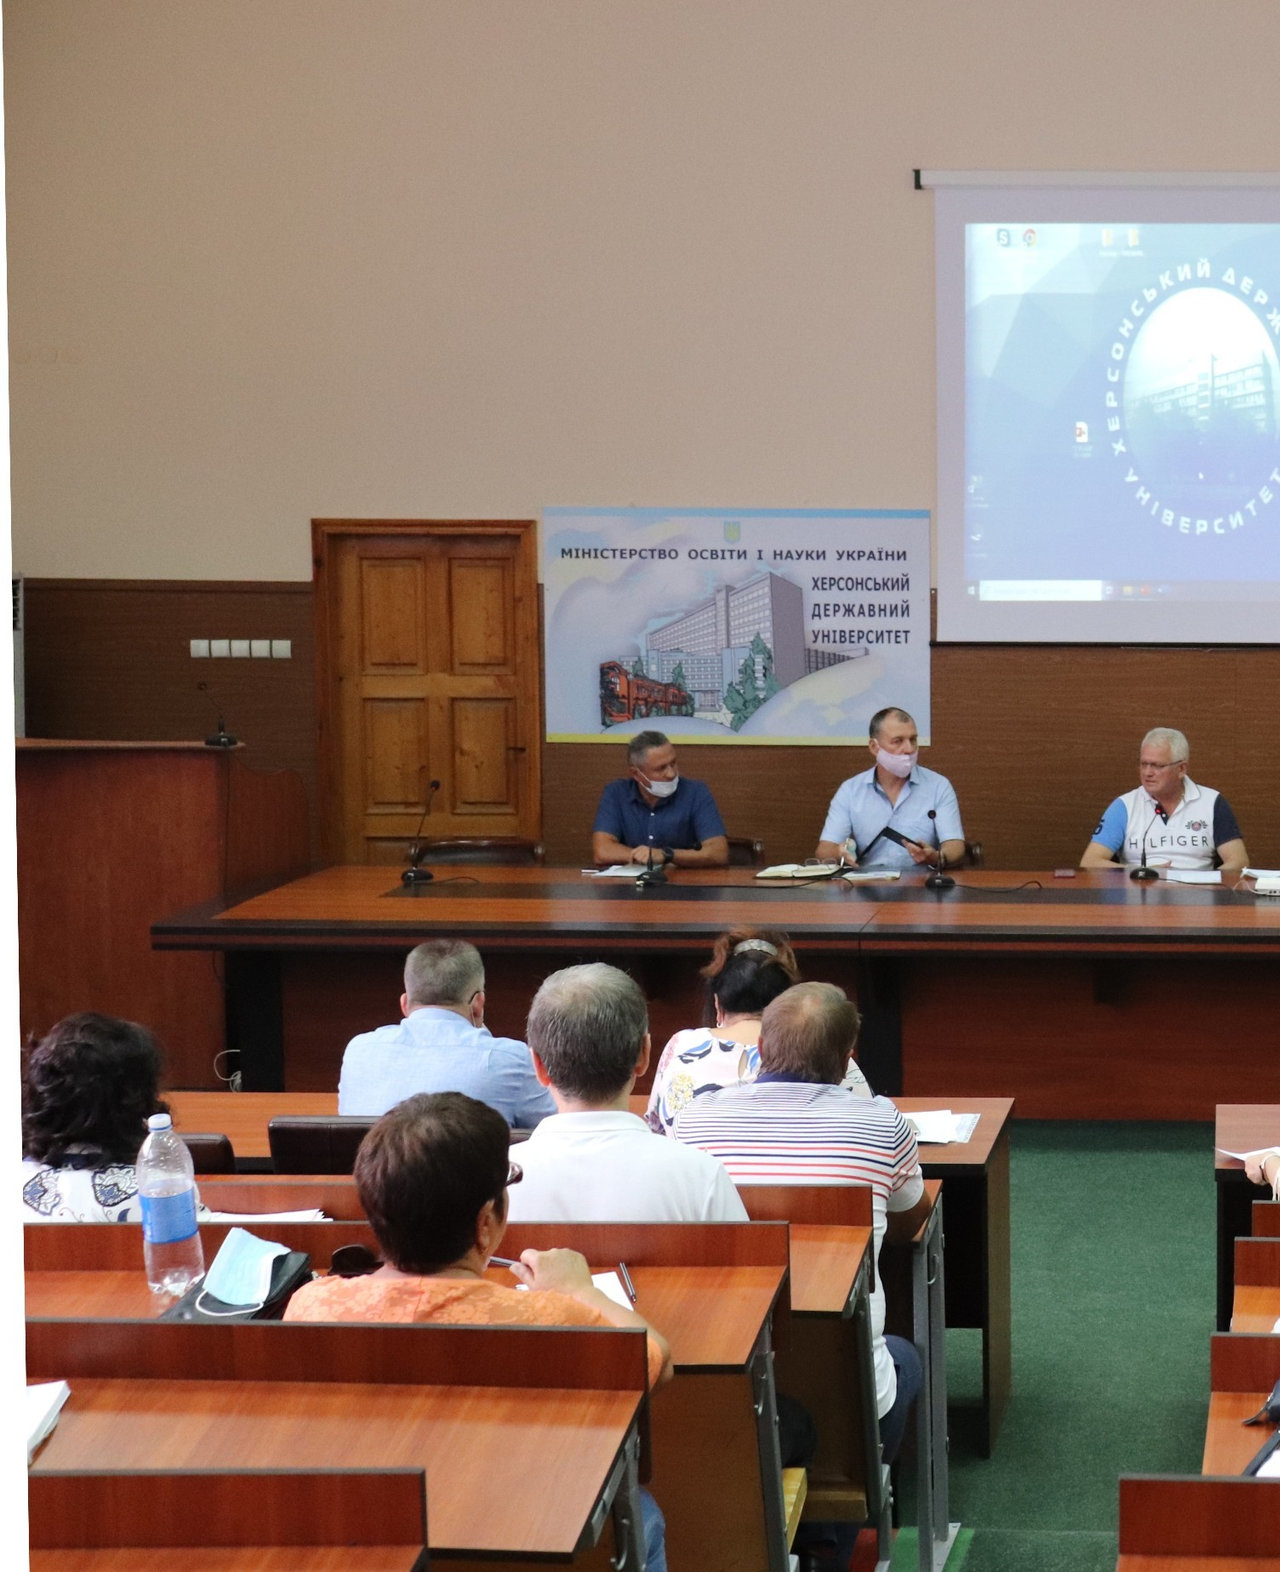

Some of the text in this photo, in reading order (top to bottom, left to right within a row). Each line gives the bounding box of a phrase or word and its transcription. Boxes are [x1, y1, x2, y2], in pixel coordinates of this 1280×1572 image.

[1106, 258, 1211, 456] ХЕРСОНСЬКИЙ
[561, 547, 907, 562] МІНІСТЕРСТВО ОСВІТИ І НАУКИ УКРАЇНИ
[812, 573, 910, 592] ХЕРСОНСЬКИЙ
[811, 601, 910, 620] ДЕРЖАВНИЙ
[811, 629, 911, 645] УНІВЕРСИТЕТ
[1129, 835, 1209, 849] HLFIGER
